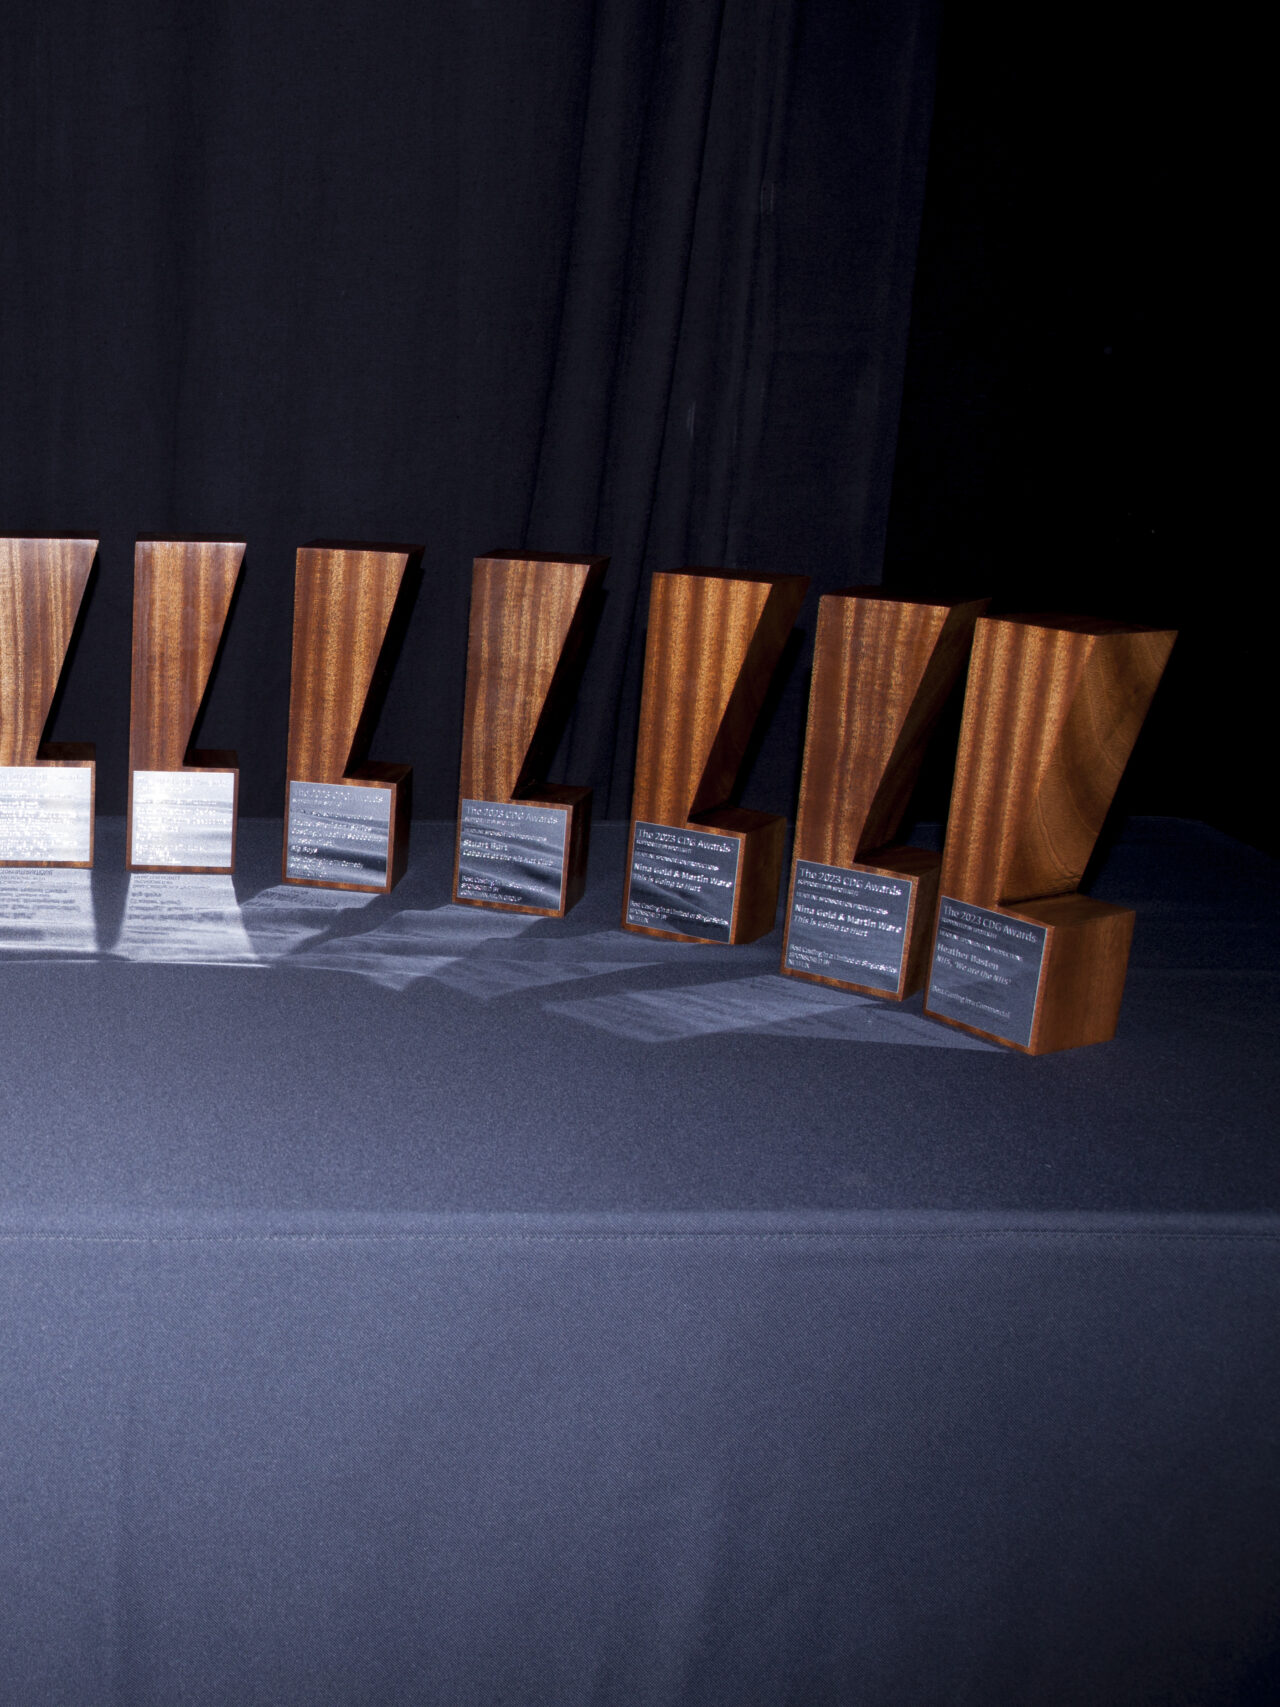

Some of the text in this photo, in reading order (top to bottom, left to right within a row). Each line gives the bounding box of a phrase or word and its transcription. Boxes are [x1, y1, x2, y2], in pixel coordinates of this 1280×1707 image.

[467, 806, 482, 815] The
[525, 813, 558, 824] Awards
[463, 839, 488, 849] Stuart
[639, 829, 653, 838] The
[655, 832, 675, 842] 2023
[677, 837, 695, 846] CDG
[697, 840, 730, 852] Awards
[633, 873, 647, 882] This
[654, 878, 675, 887] Going
[684, 884, 701, 892] Hurt
[634, 863, 652, 872] Nina
[653, 868, 672, 876] Gold
[681, 872, 708, 883] Martin
[710, 878, 732, 887] Ware
[800, 868, 901, 895] The 2023 CDG Awards
[794, 915, 809, 924] This
[817, 921, 839, 931] Going
[850, 928, 868, 937] Hurt
[795, 904, 814, 914] Nina
[816, 909, 836, 919] Gold
[847, 915, 876, 927] Martin
[878, 922, 901, 933] Ware
[944, 905, 1036, 942] The 2023 CDG Awards
[936, 955, 952, 967] NHS,
[967, 966, 979, 976] are
[980, 971, 992, 979] the
[937, 943, 968, 959] Heather
[970, 955, 998, 970] Basten
